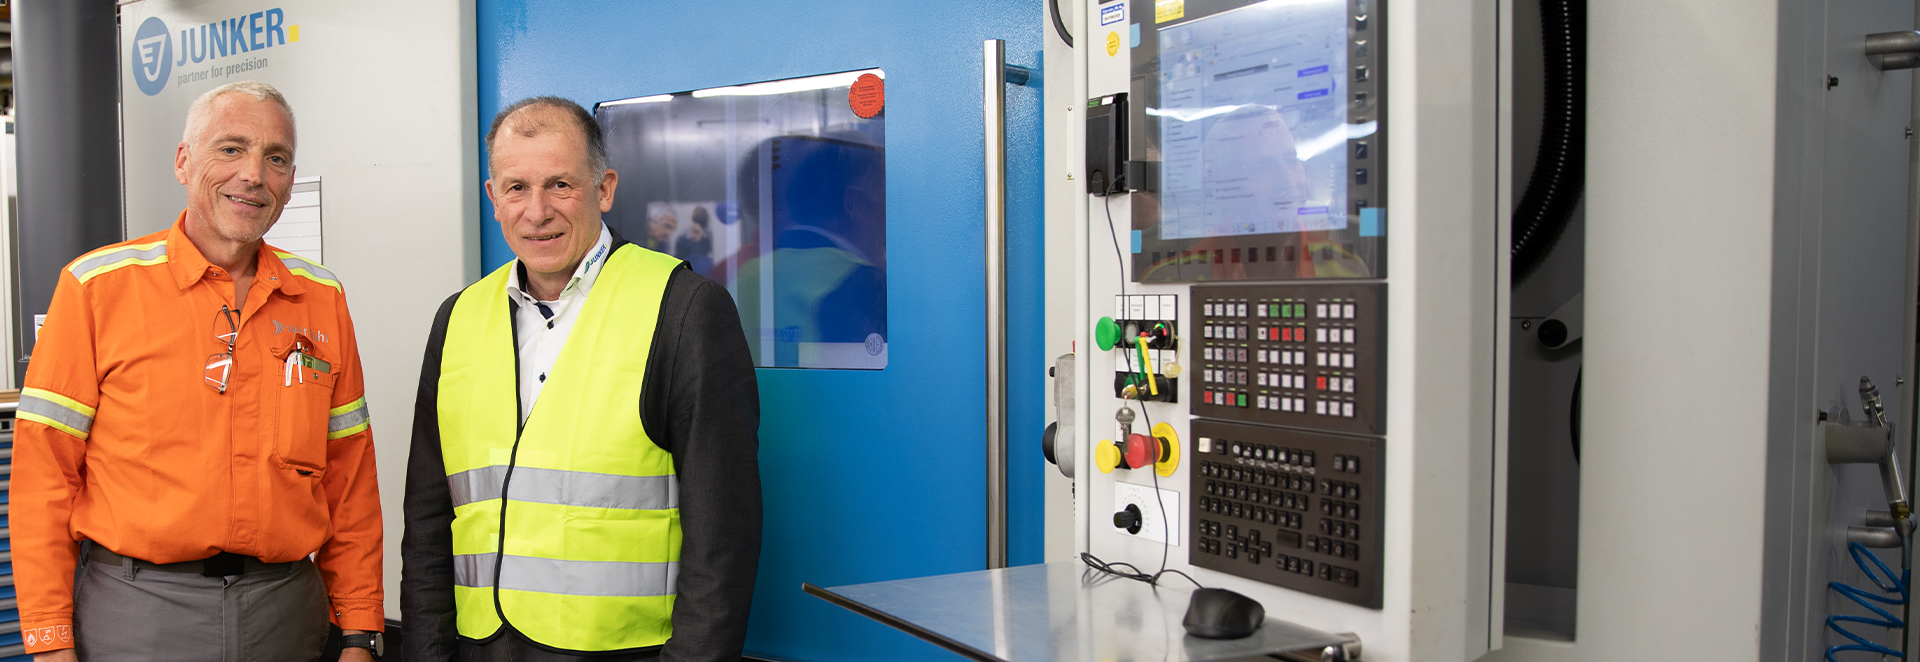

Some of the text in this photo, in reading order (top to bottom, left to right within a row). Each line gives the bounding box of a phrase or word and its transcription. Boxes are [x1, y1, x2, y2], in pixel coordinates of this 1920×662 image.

[176, 7, 286, 67] JUNKER
[177, 57, 268, 88] partner for precision
